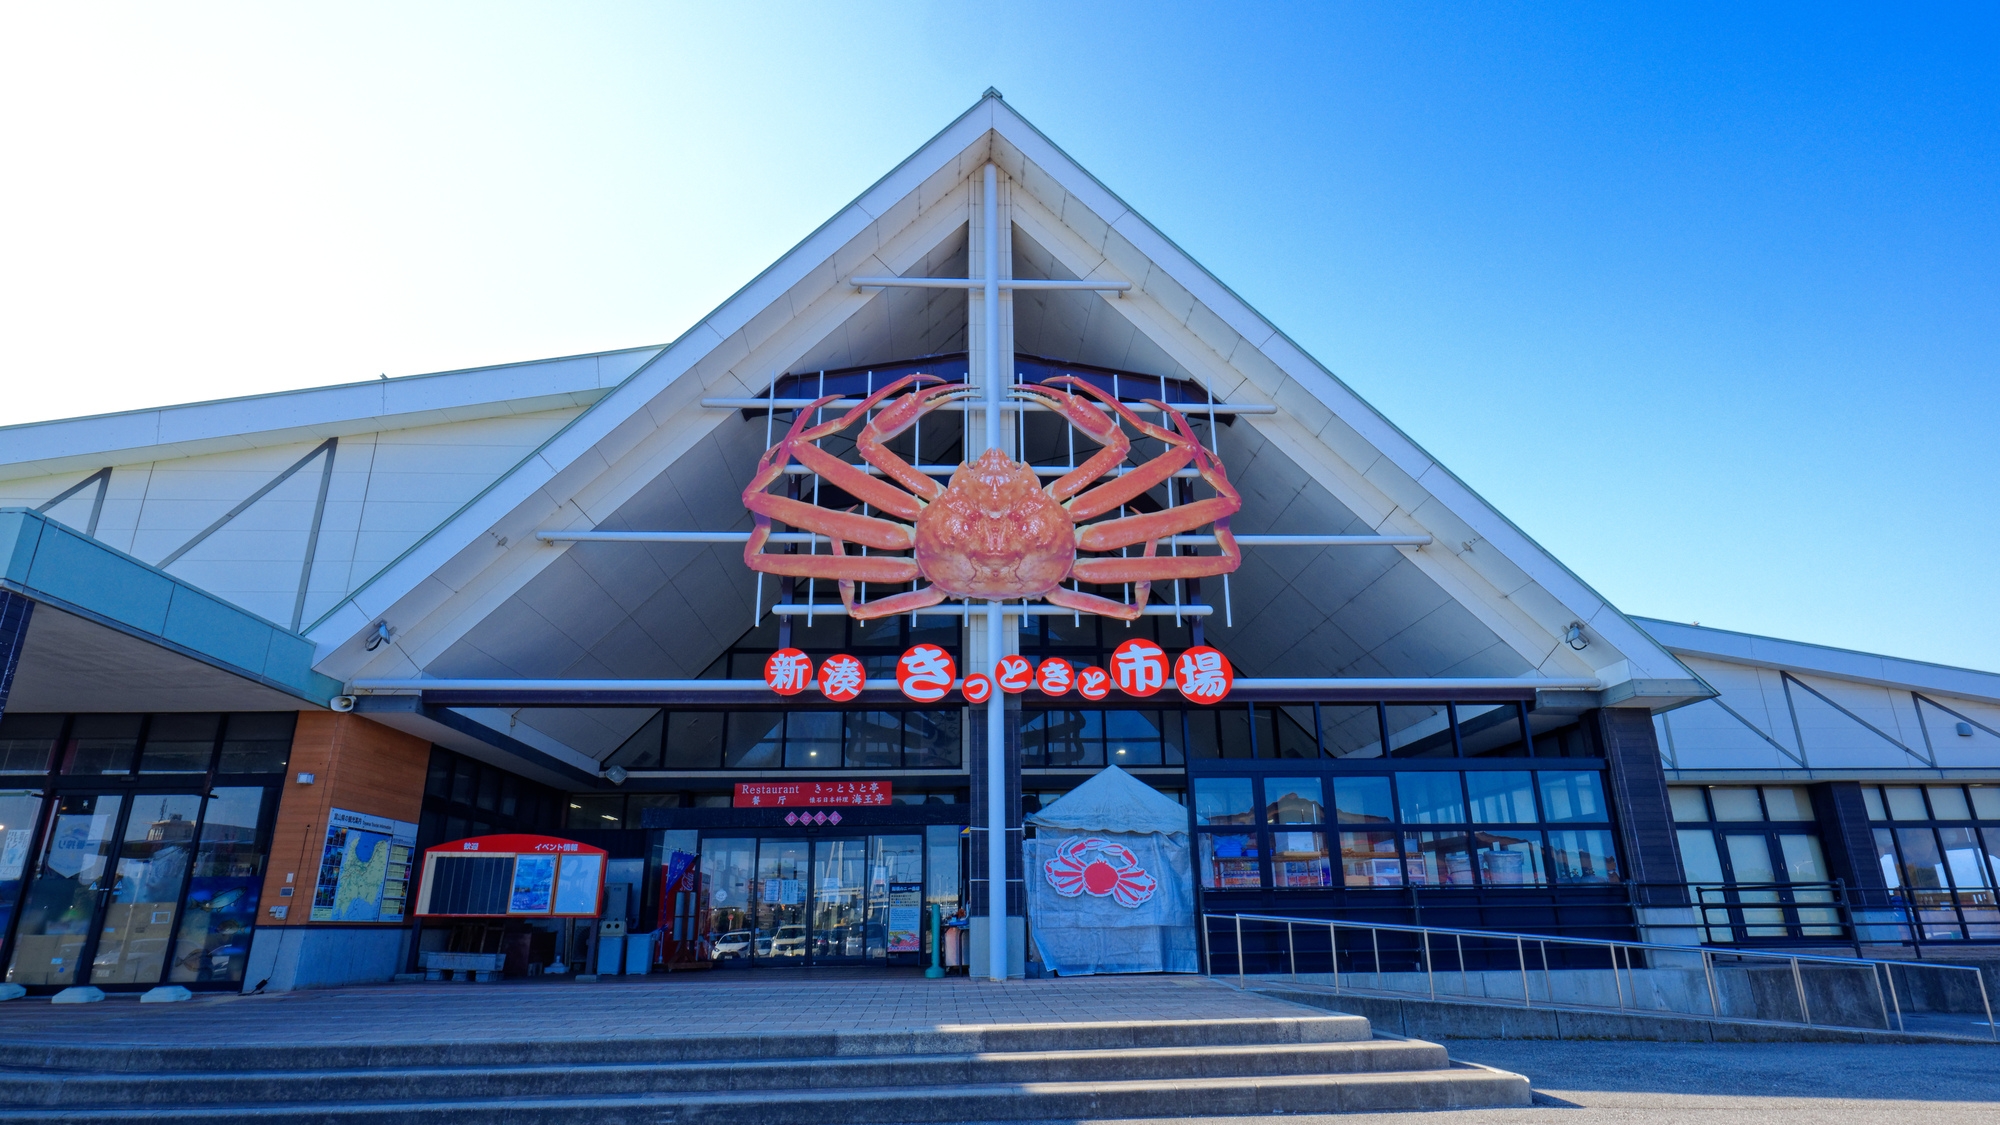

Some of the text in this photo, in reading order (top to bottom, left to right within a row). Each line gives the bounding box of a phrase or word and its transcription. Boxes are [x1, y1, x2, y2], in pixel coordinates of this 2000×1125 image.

[741, 784, 800, 794] Restaurant
[814, 782, 880, 793] きっときと亭
[463, 842, 479, 850] 歓迎
[534, 843, 579, 851] イベント情報
